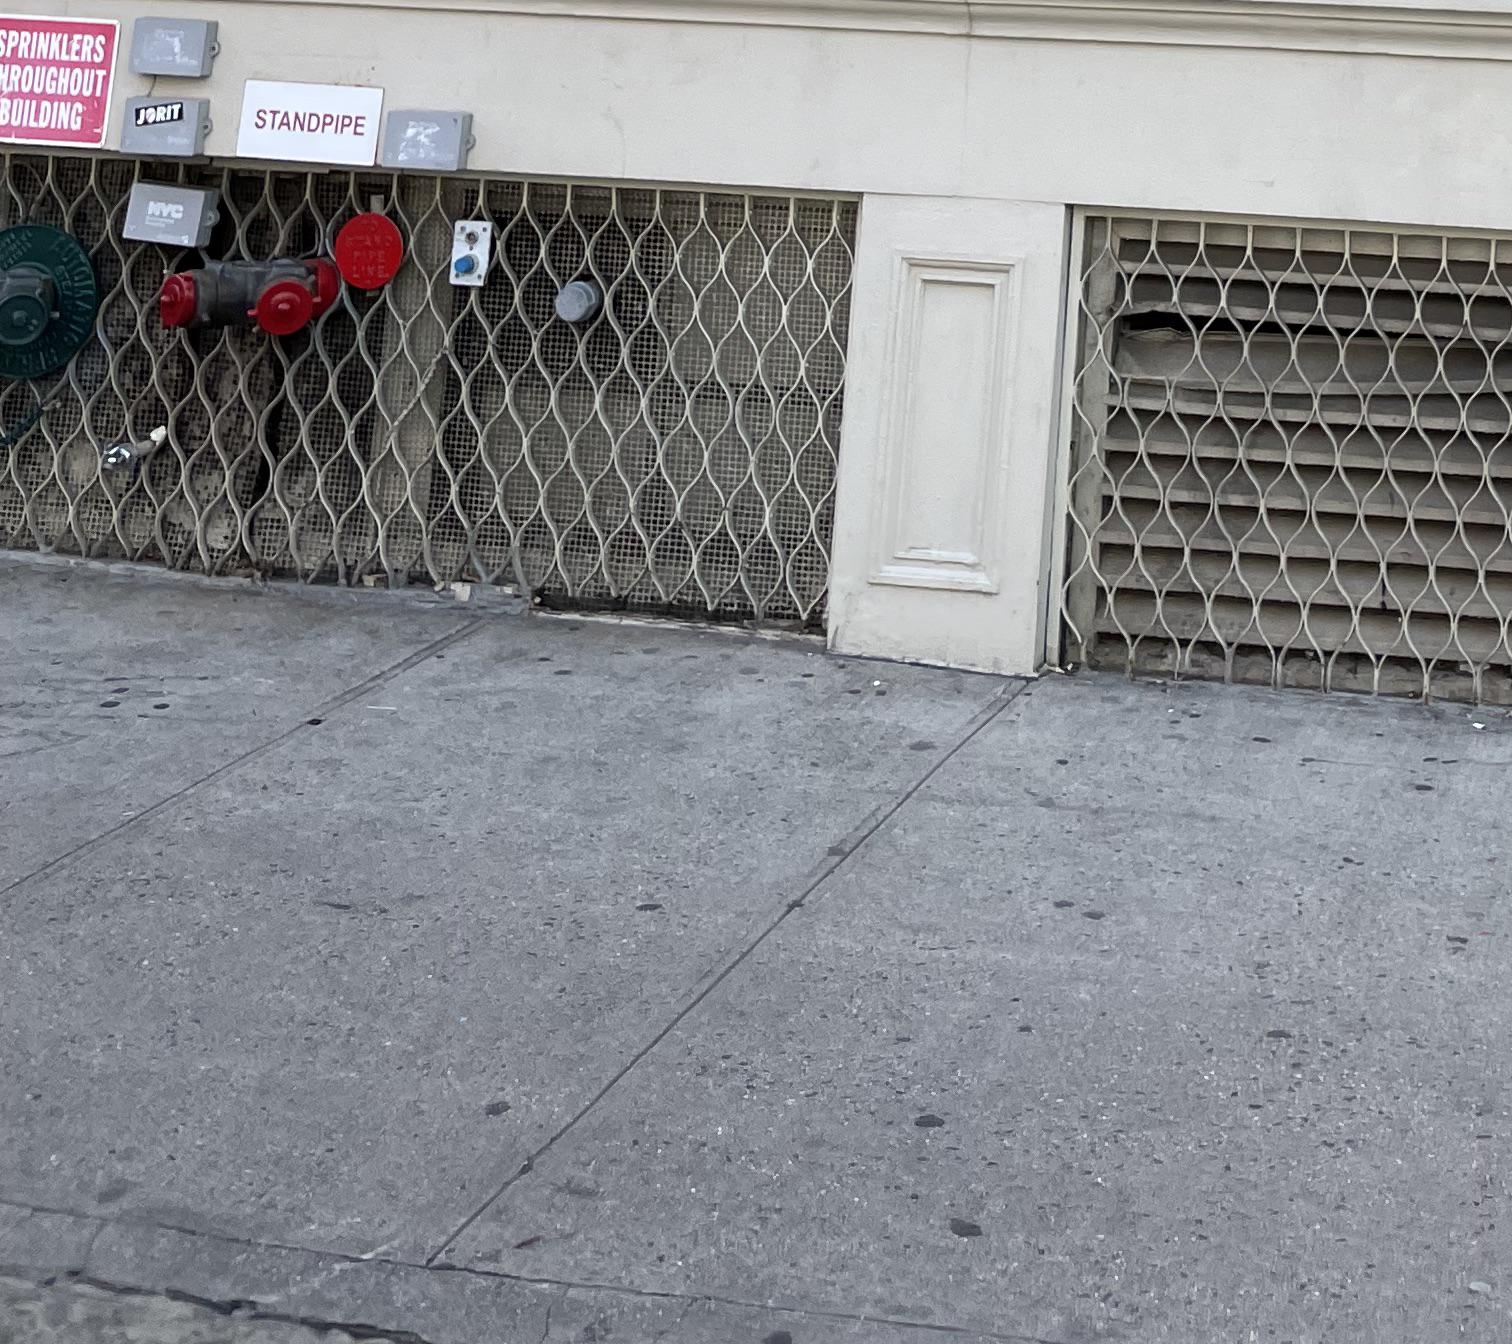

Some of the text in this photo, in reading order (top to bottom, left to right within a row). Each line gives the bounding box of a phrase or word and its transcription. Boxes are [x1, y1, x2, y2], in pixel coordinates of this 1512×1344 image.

[0, 29, 106, 63] SPRINKLERS
[0, 98, 83, 131] BUILDING
[136, 102, 182, 126] JORIT
[254, 109, 366, 136] STANDPIPE
